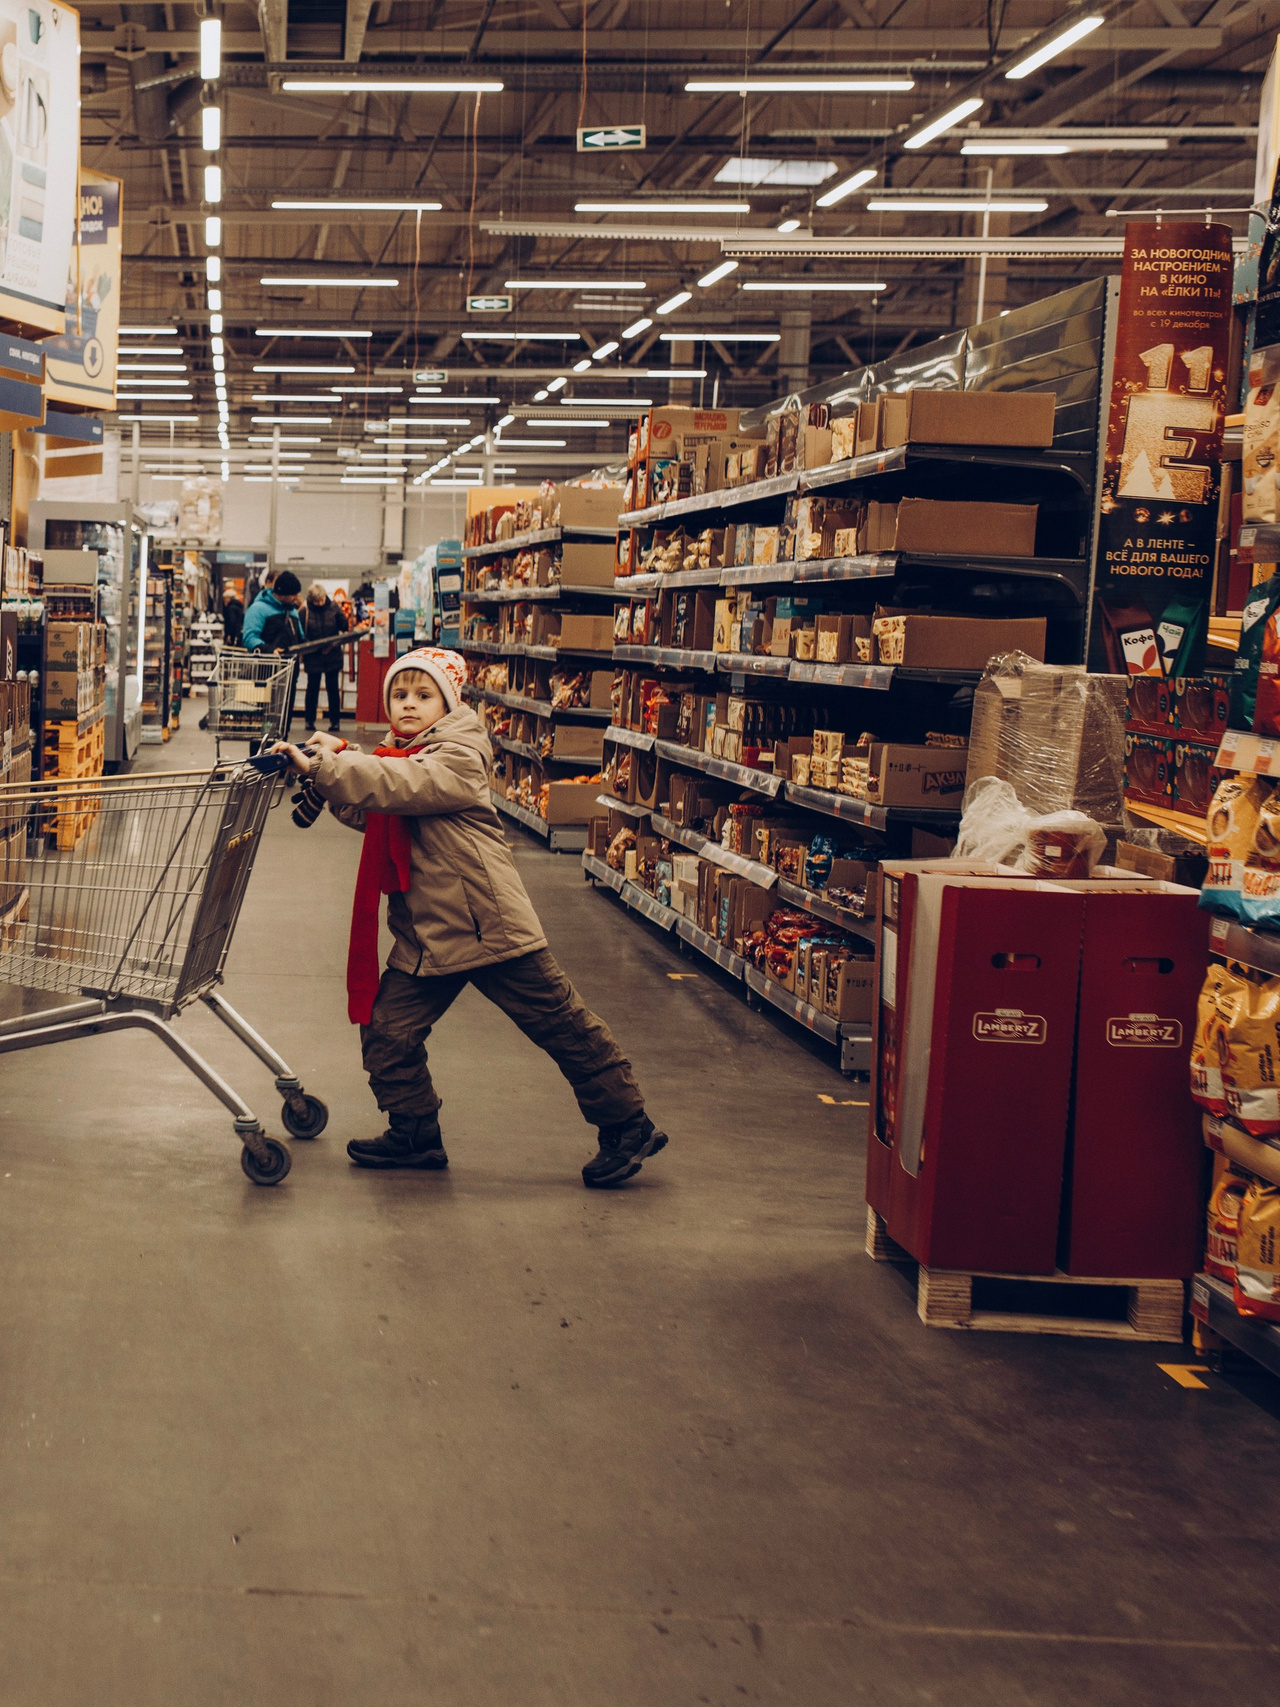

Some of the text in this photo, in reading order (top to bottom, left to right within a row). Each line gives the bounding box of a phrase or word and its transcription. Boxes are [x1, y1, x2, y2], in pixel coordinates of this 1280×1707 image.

[1130, 249, 1231, 262] ЗА НОВОГОДНИМ
[1133, 261, 1220, 272] НАСТРОЕНИЕМ
[1160, 274, 1207, 285] В КИНО
[1140, 286, 1158, 296] НА
[1160, 319, 1171, 328] 19
[1172, 320, 1210, 330] декабря
[1123, 538, 1133, 548] А
[1136, 538, 1144, 548] В
[1146, 539, 1185, 550] ЛЕНТЕ
[1105, 550, 1210, 565] ВСЁ ДЛЯ ВАШЕГО
[1110, 564, 1204, 579] НОВОГО ГОДА!
[1124, 633, 1153, 646] Кофе
[924, 771, 966, 792] АКУЛ
[977, 1019, 1040, 1037] LAMBERTZ
[1111, 1025, 1175, 1041] LAMBERTZ
